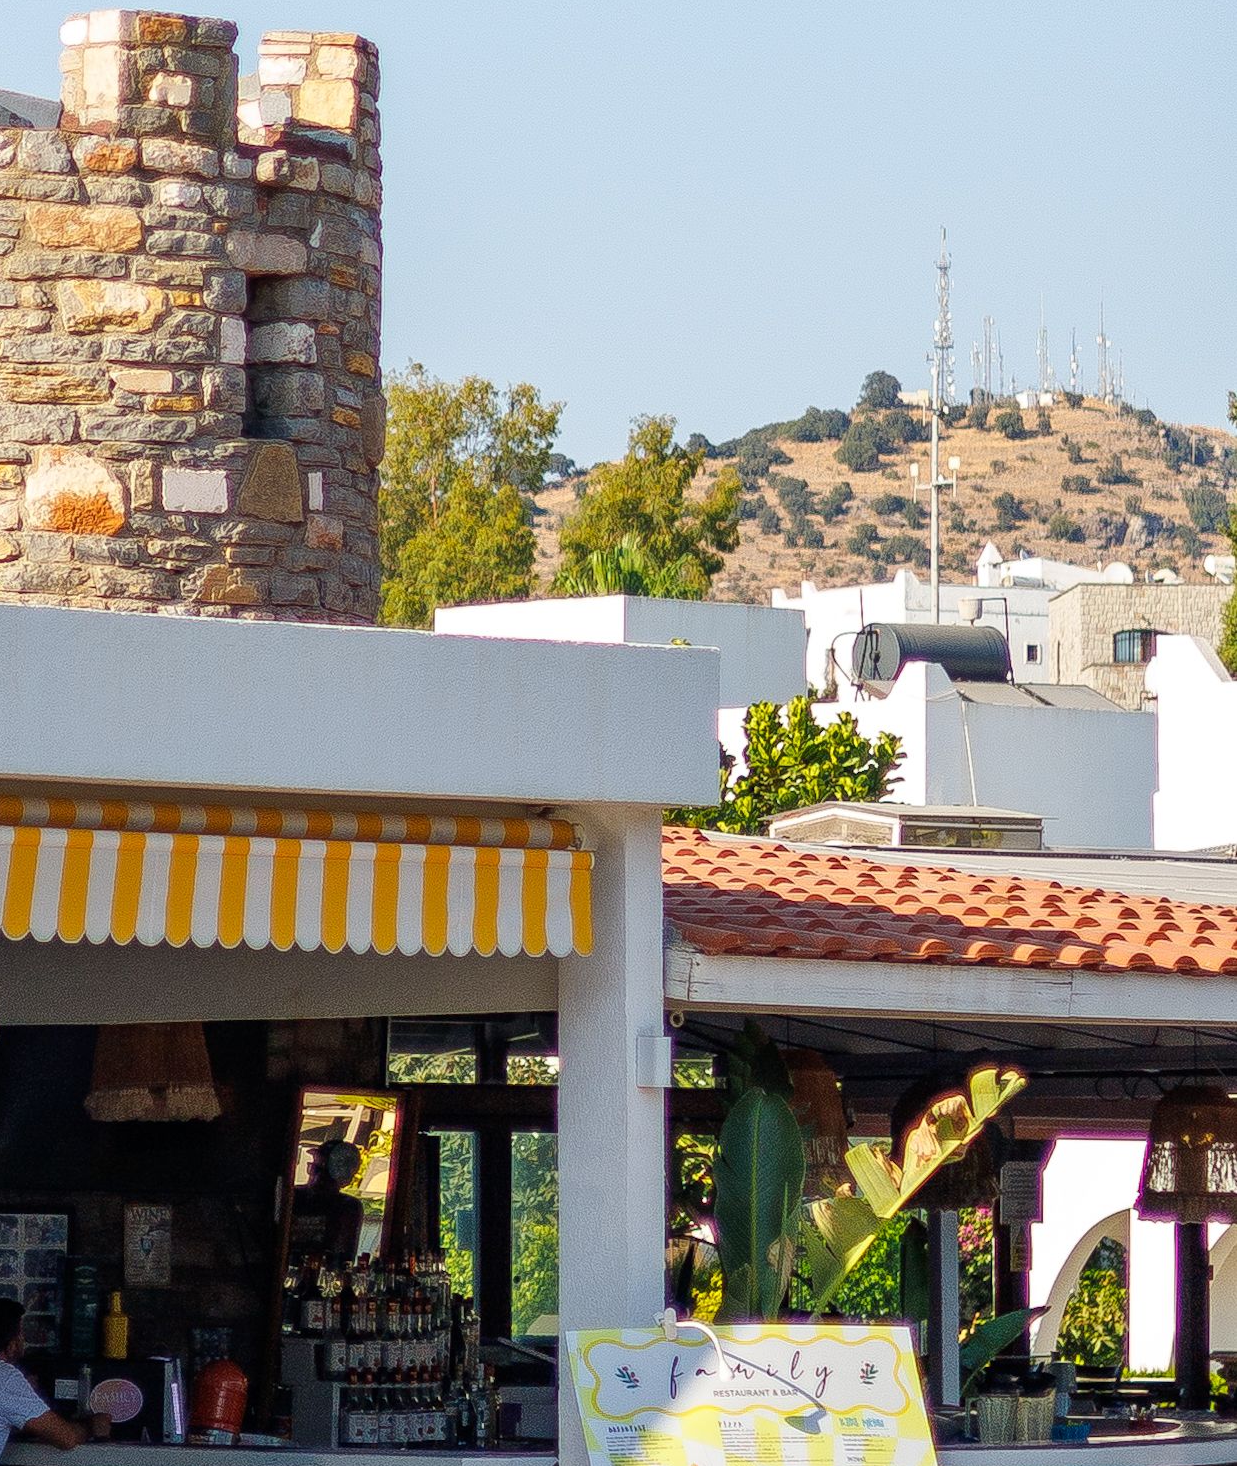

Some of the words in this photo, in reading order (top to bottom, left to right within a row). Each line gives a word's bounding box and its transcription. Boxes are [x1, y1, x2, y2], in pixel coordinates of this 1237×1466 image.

[670, 1350, 833, 1399] family
[713, 1389, 770, 1398] RESTAURANT
[773, 1389, 778, 1397] &
[780, 1388, 798, 1397] BAR
